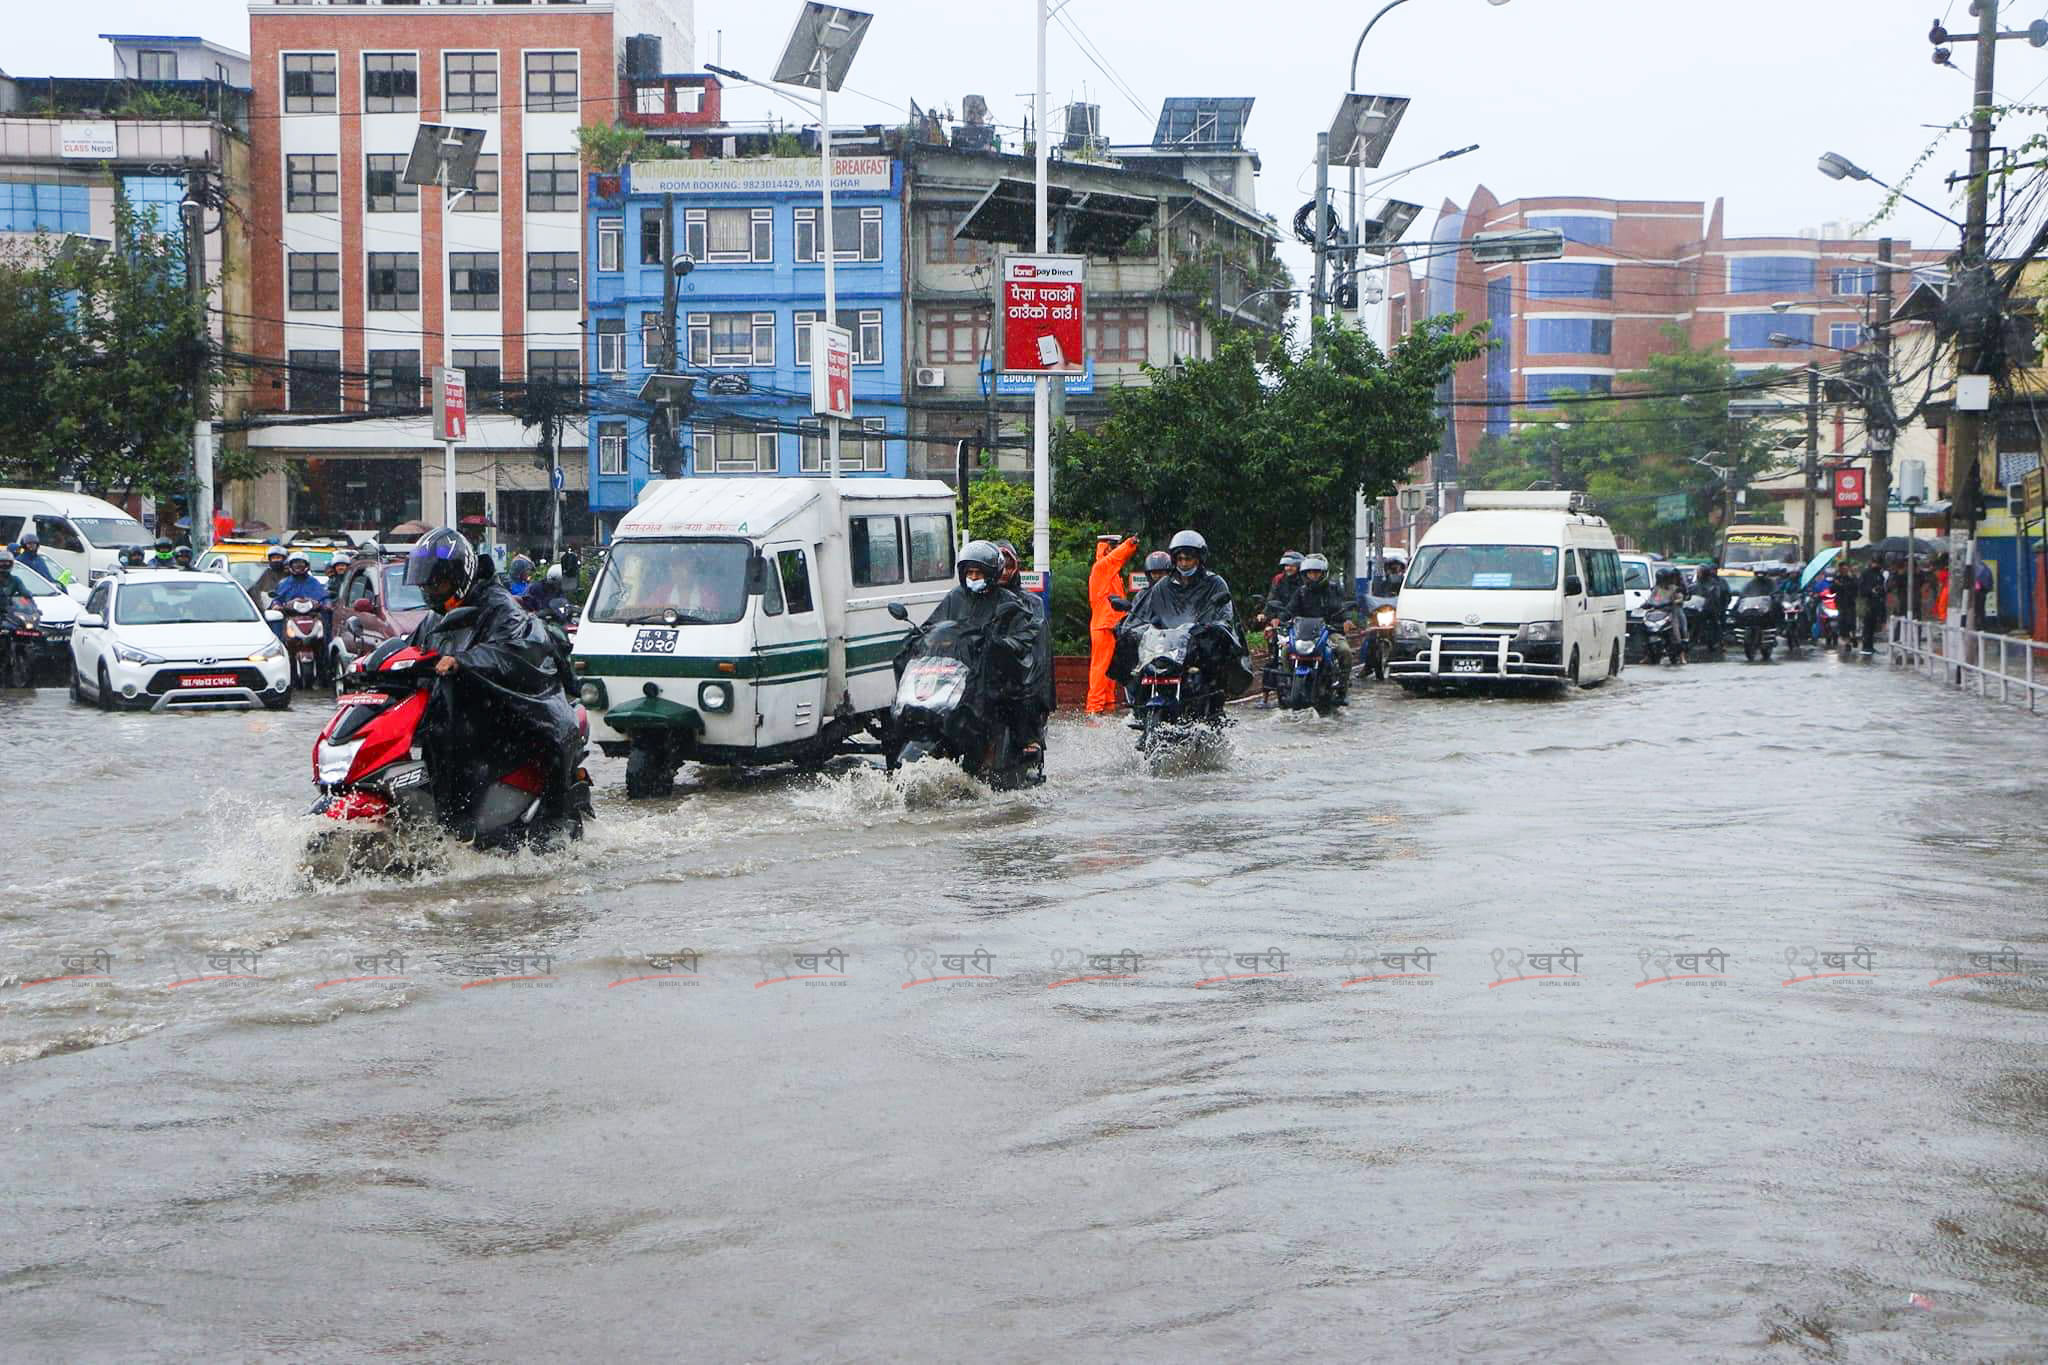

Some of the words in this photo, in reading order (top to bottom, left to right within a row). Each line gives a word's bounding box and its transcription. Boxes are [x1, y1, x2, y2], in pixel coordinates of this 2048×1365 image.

[91, 144, 114, 152] Nepal
[835, 159, 887, 175] BREAKFAST
[660, 181, 690, 190] ROOM
[693, 180, 741, 190] BOOKING:
[743, 179, 802, 189] 9823014429,
[1052, 268, 1073, 276] Direct
[1011, 283, 1036, 301] पैसा
[738, 521, 748, 533] A
[634, 640, 675, 652] ३७२०
